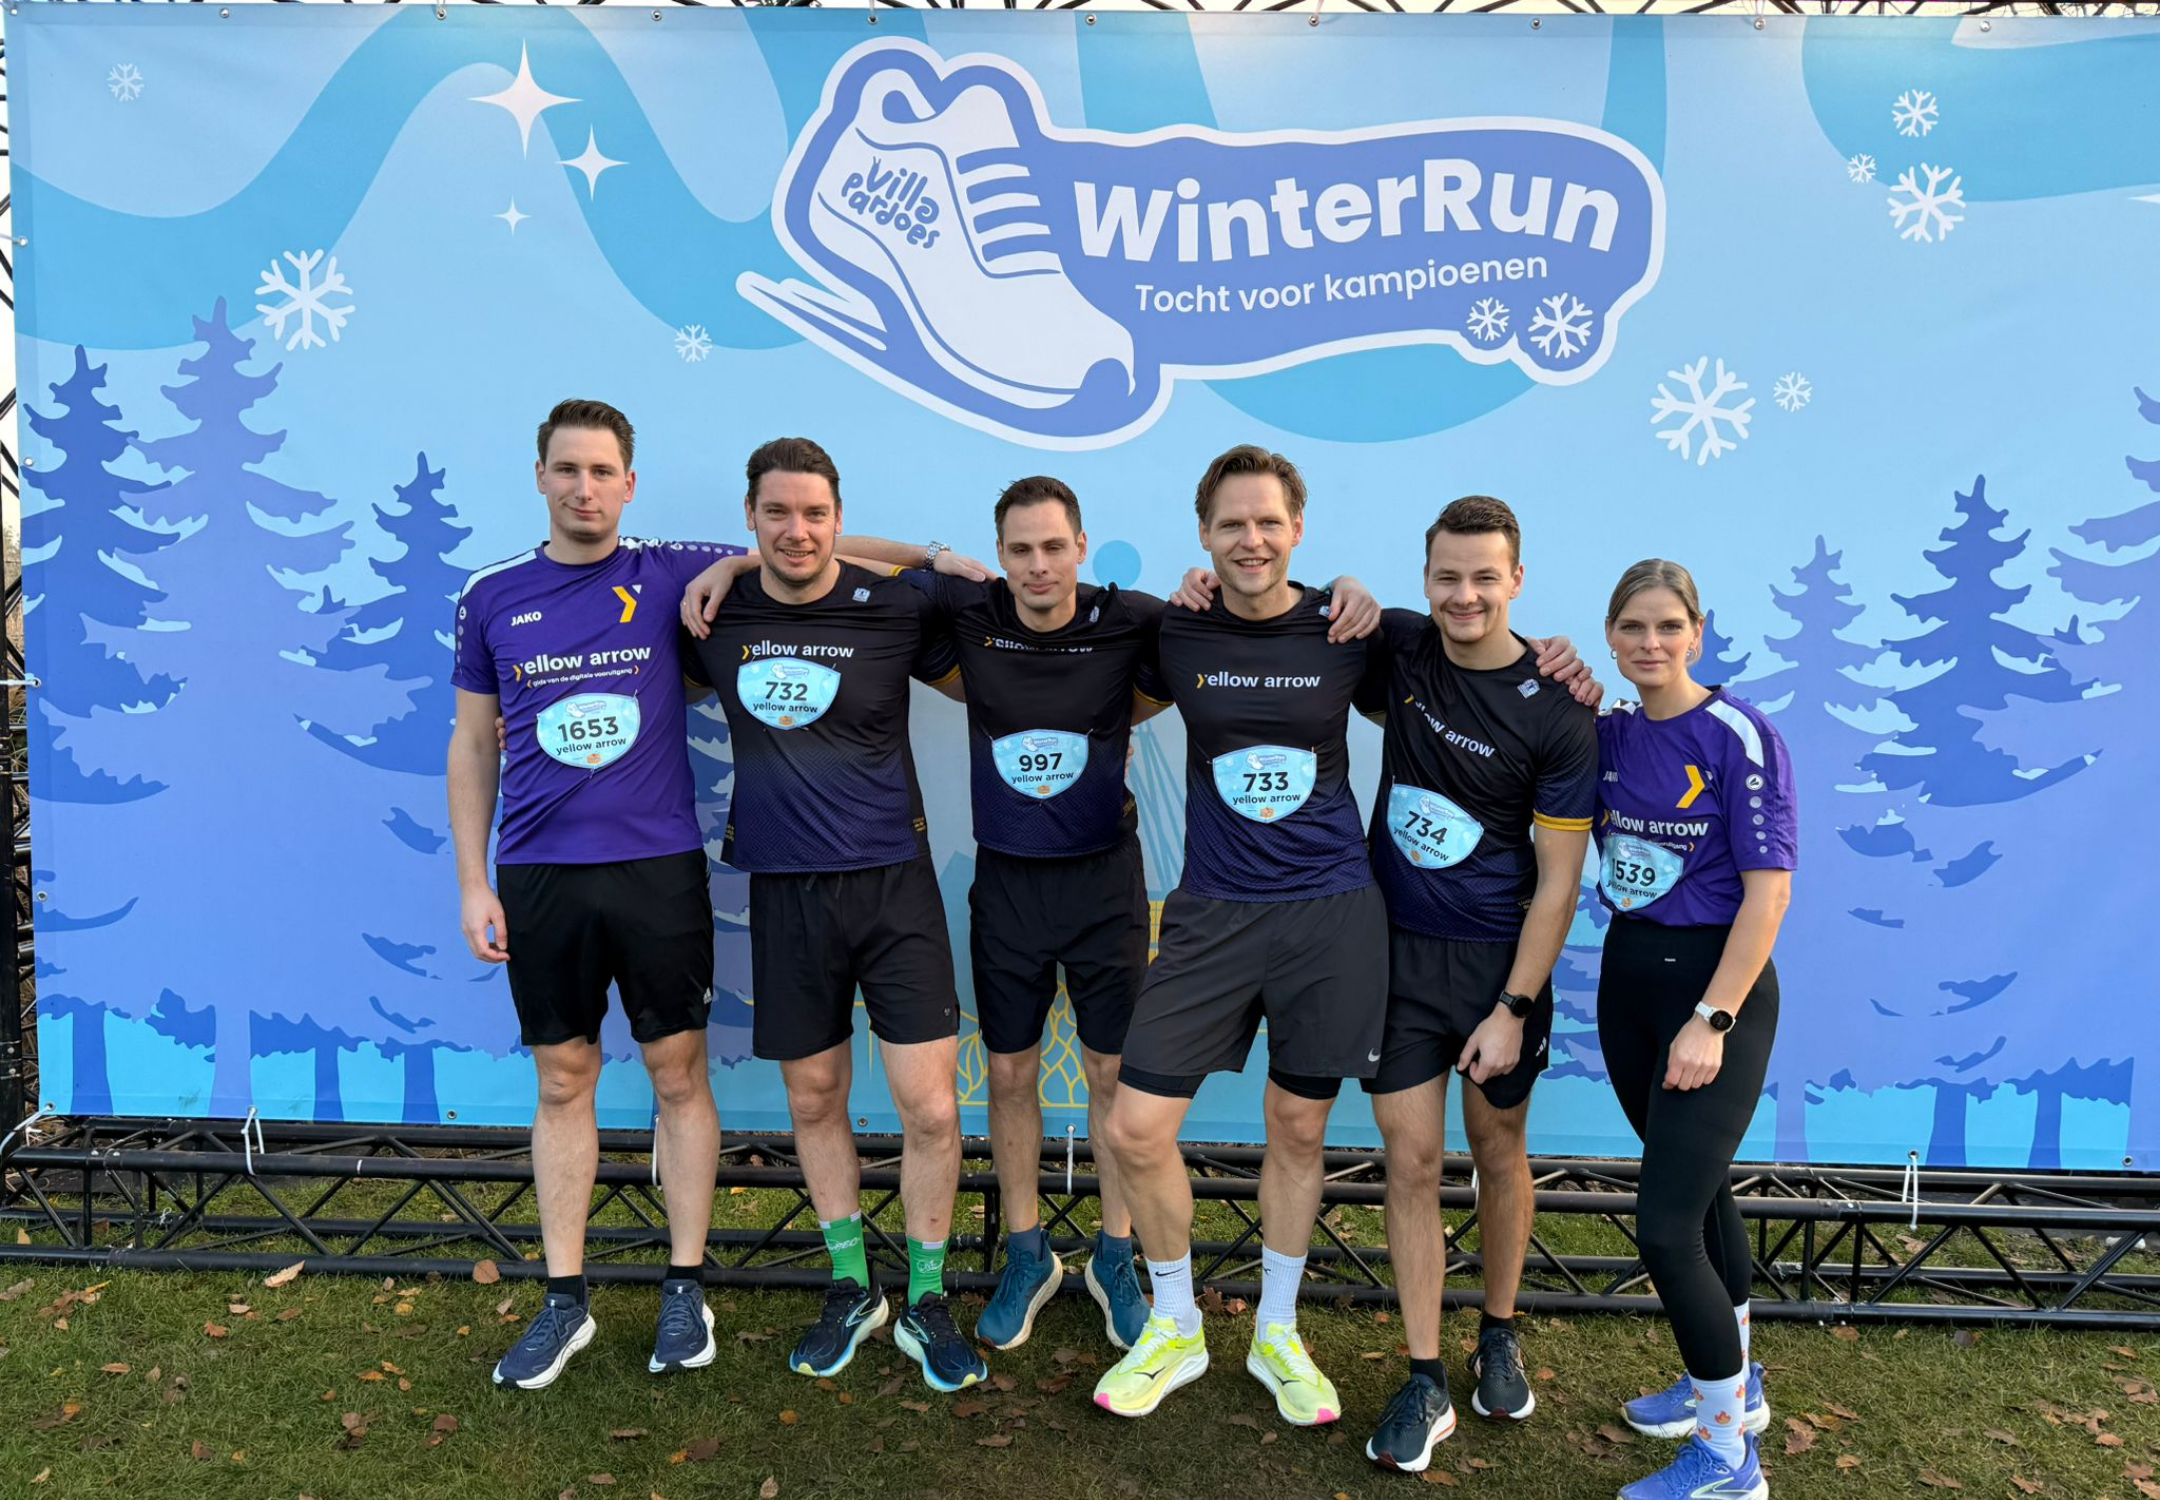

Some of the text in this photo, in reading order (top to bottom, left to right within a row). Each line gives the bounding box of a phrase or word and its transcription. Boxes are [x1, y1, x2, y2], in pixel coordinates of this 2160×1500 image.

[866, 155, 940, 225] Villa
[1074, 158, 1620, 262] WinterRun
[1135, 256, 1548, 312] Tocht voor kampioenen
[511, 611, 543, 626] JAKO
[590, 647, 651, 664] arrow
[802, 645, 854, 658] arrow
[765, 681, 808, 701] 732
[1264, 676, 1321, 688] arrow
[753, 702, 818, 713] yellow arrow
[558, 716, 619, 742] 1653
[556, 737, 626, 756] yellow arrow
[1445, 730, 1496, 758] arrow
[1019, 753, 1063, 772] 997
[1011, 771, 1074, 784] yellow arrow
[1243, 772, 1289, 792] 733
[1232, 793, 1301, 805] yellow arrow
[1404, 811, 1447, 845] 734
[1649, 820, 1709, 836] arrow
[1394, 827, 1449, 861] yellow arrow
[1612, 858, 1656, 887] 1539
[1630, 888, 1657, 898] arrow
